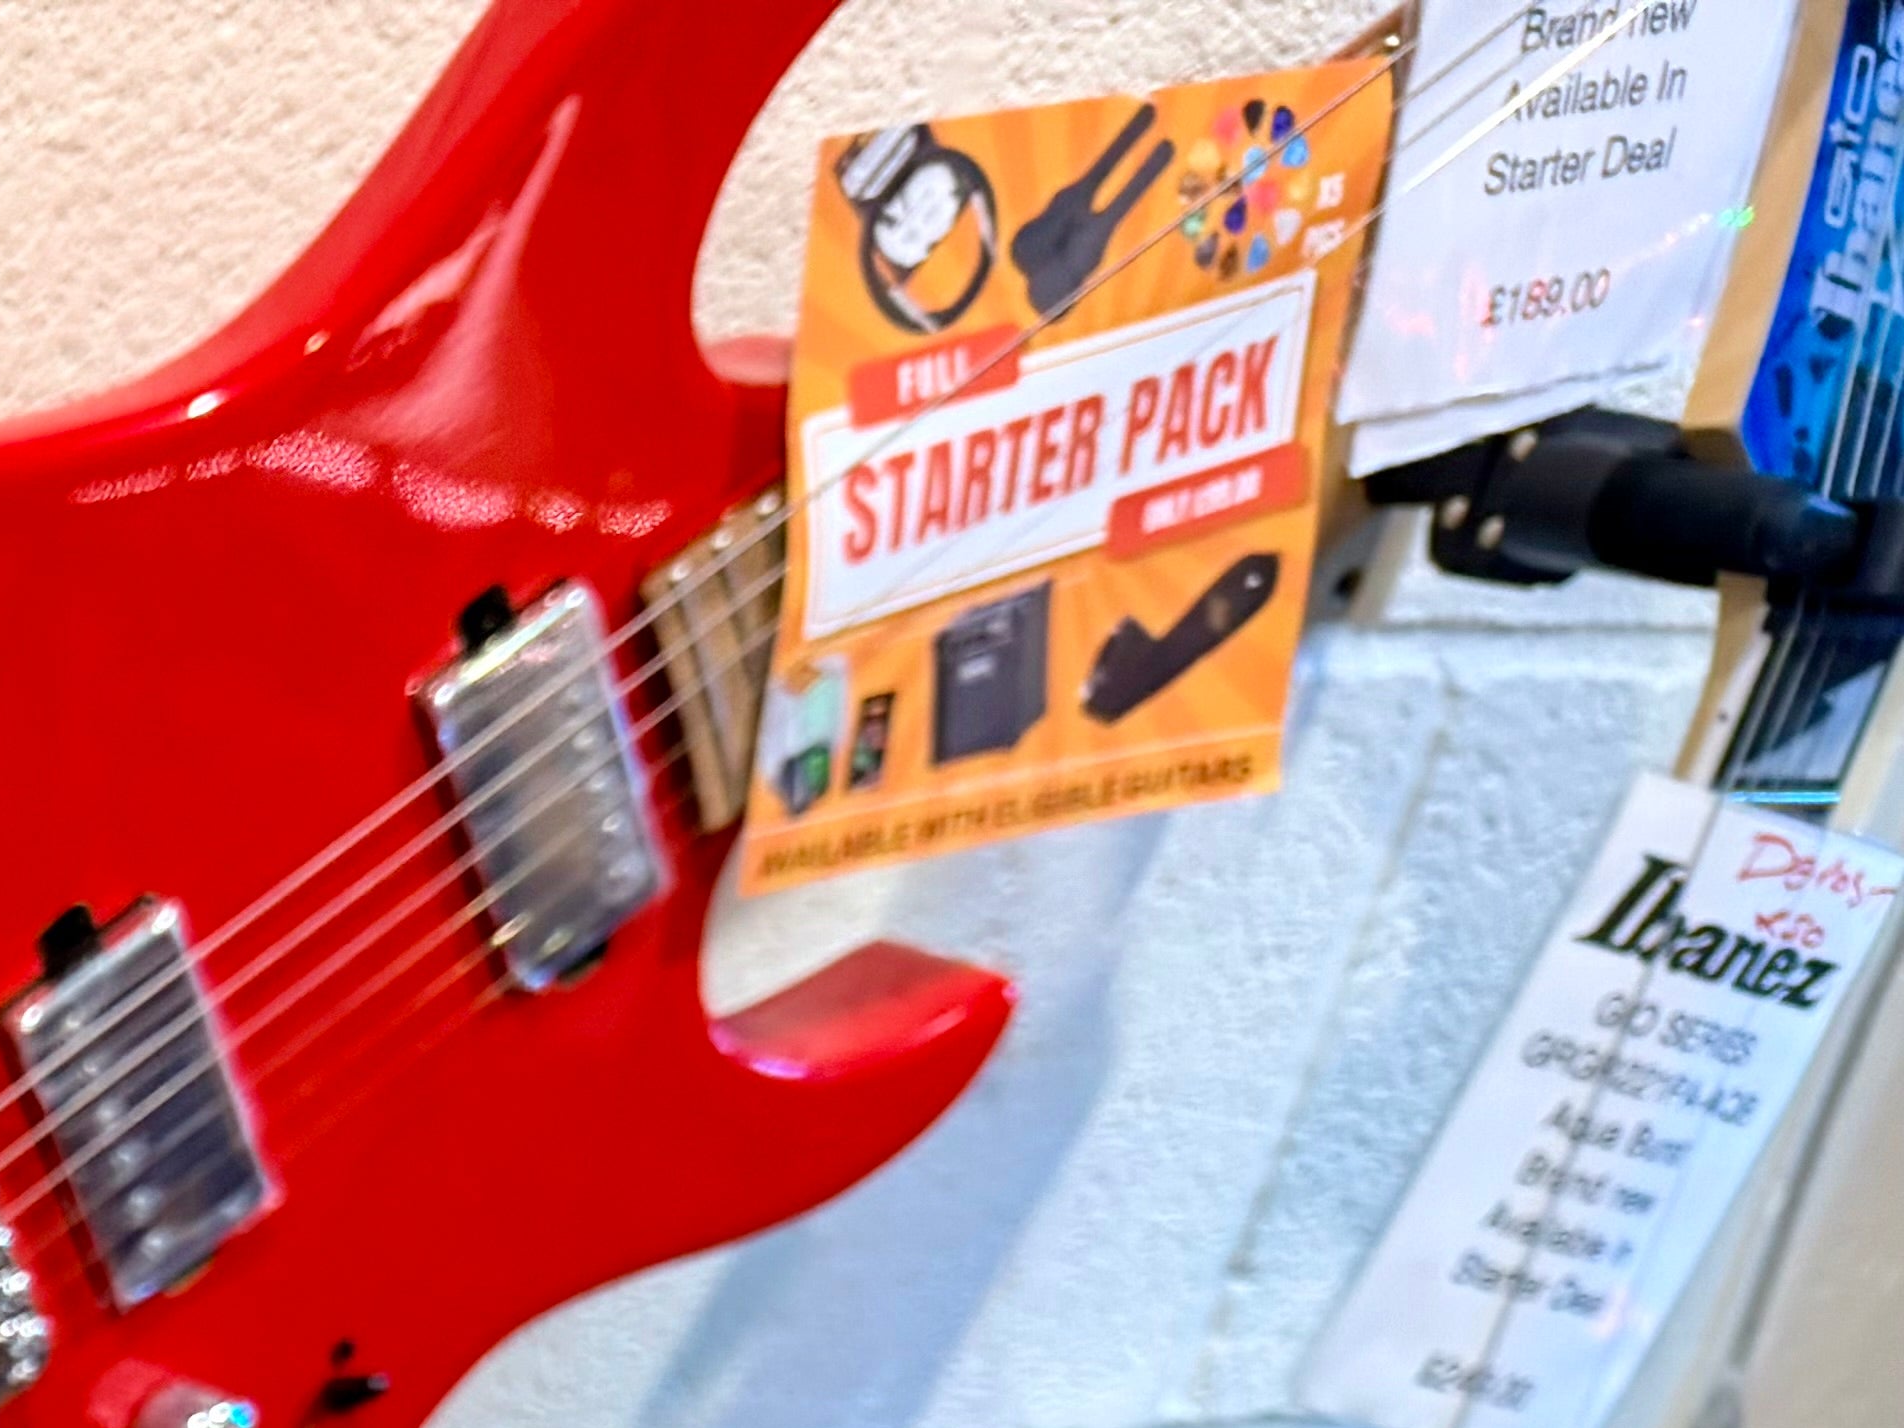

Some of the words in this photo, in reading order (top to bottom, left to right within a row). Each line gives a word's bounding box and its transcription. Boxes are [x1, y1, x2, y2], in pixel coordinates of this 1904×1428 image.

[1521, 0, 1620, 54] Brand
[1505, 65, 1648, 122] Available
[1656, 58, 1687, 102] In
[1483, 148, 1596, 196] Starter
[1601, 124, 1678, 179] Deal
[897, 346, 970, 406] FULL
[840, 394, 1105, 566] STARTER
[1117, 334, 1279, 475] PACK
[758, 823, 909, 878] AVAILABLE
[915, 807, 986, 846] WITH
[1121, 753, 1252, 800] GUITARS
[1576, 853, 1841, 1009] Ibanez
[1659, 1008, 1758, 1066] SERIES
